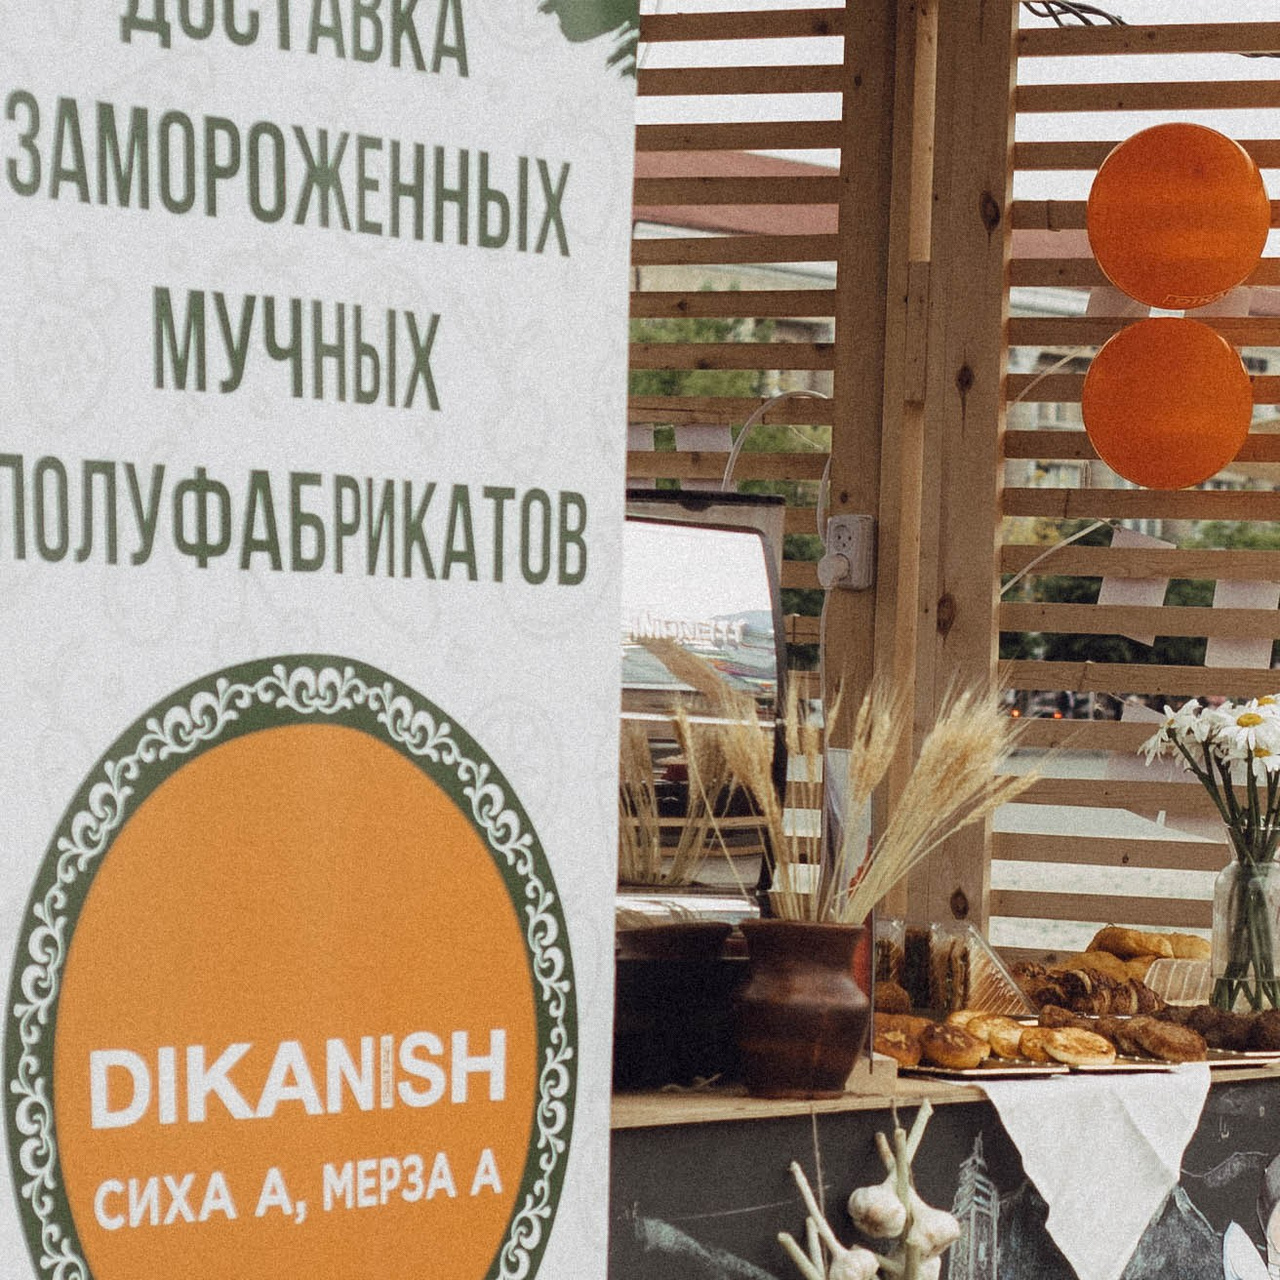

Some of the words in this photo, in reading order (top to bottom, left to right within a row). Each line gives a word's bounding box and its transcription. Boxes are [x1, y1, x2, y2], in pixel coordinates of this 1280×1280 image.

[5, 89, 571, 257] ЗАМОРОЖЕННЫХ
[152, 286, 443, 412] МУЧНЫХ
[0, 453, 588, 587] ПОЛУФАБРИКАТОВ
[89, 1028, 507, 1129] DIKANISH
[93, 1170, 238, 1231] СИХА
[254, 1166, 308, 1226] А,
[322, 1151, 457, 1212] МЕРЗА
[469, 1147, 503, 1197] А
